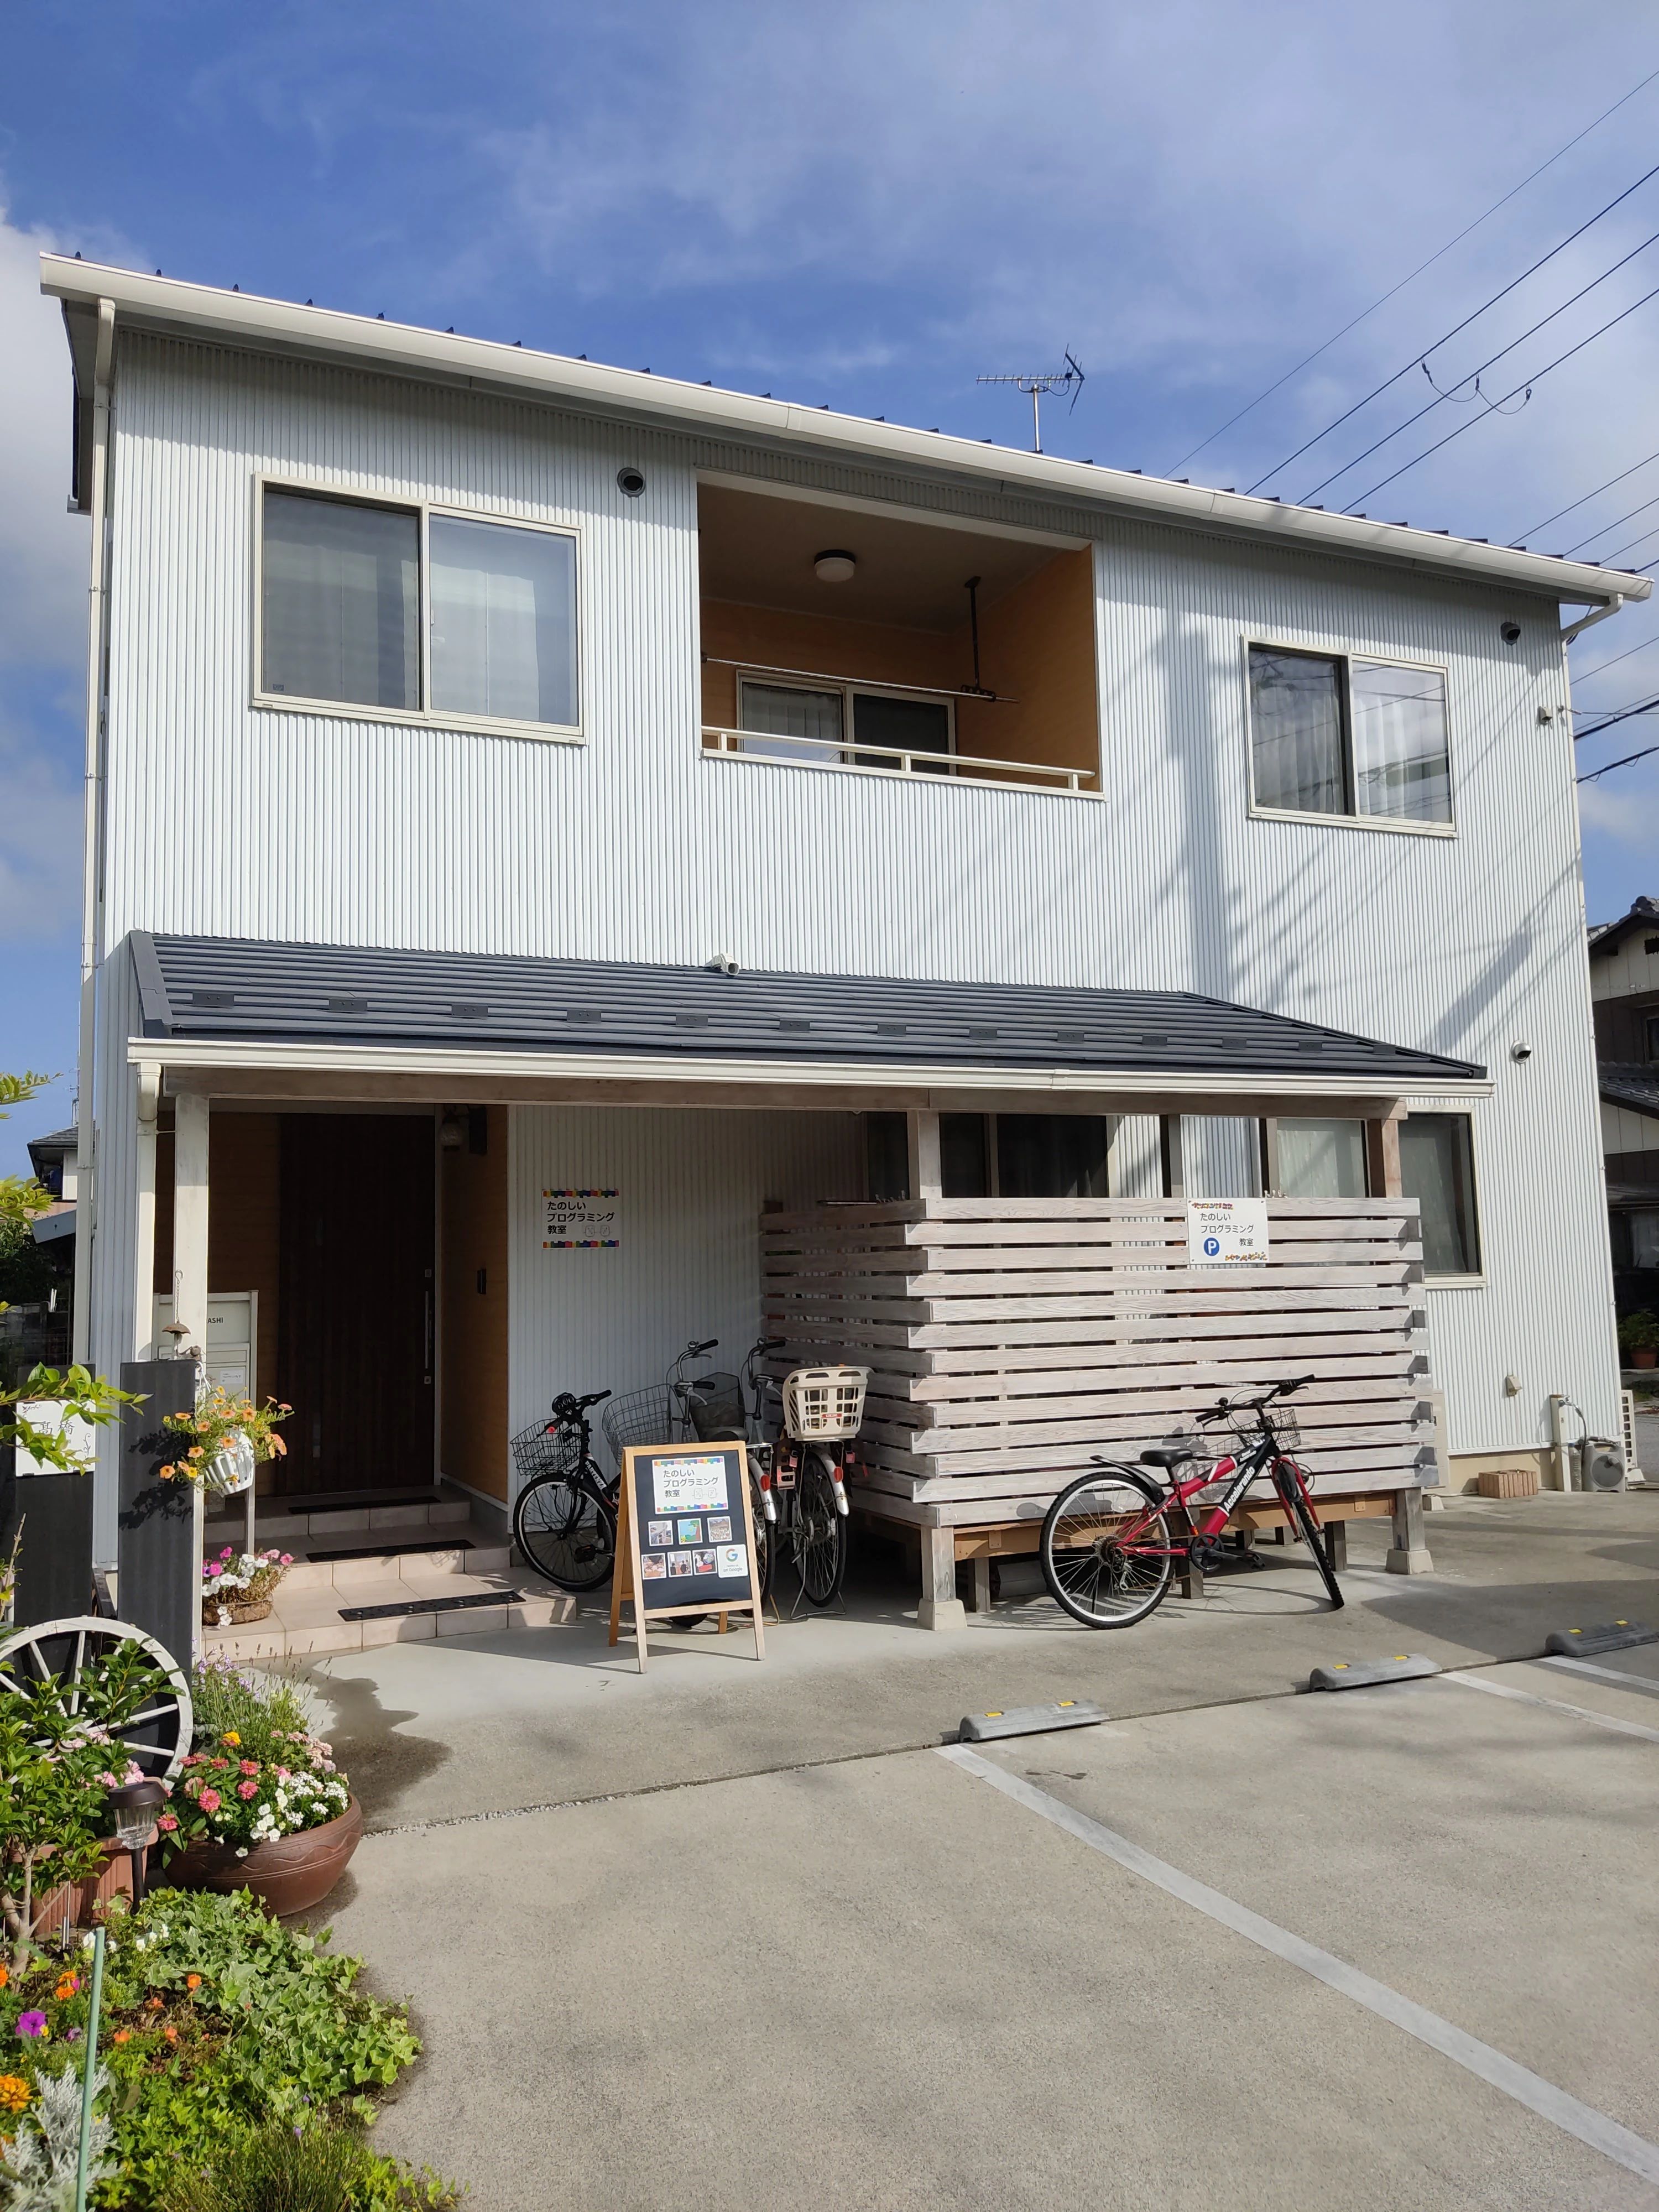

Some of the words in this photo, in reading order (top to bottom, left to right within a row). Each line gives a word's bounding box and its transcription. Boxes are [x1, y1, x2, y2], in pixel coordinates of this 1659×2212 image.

[547, 1201, 586, 1211] たのしい
[547, 1212, 615, 1222] プログラミング
[1200, 1212, 1231, 1221] たのしい
[547, 1225, 567, 1234] 教室
[1201, 1224, 1254, 1234] プログラミング
[1208, 1240, 1217, 1254] P
[1239, 1238, 1254, 1246] 教室
[662, 1469, 695, 1478] たのしい
[663, 1477, 719, 1488] プログラミング
[664, 1489, 680, 1498] 教室
[1223, 1466, 1255, 1512] Accelerando
